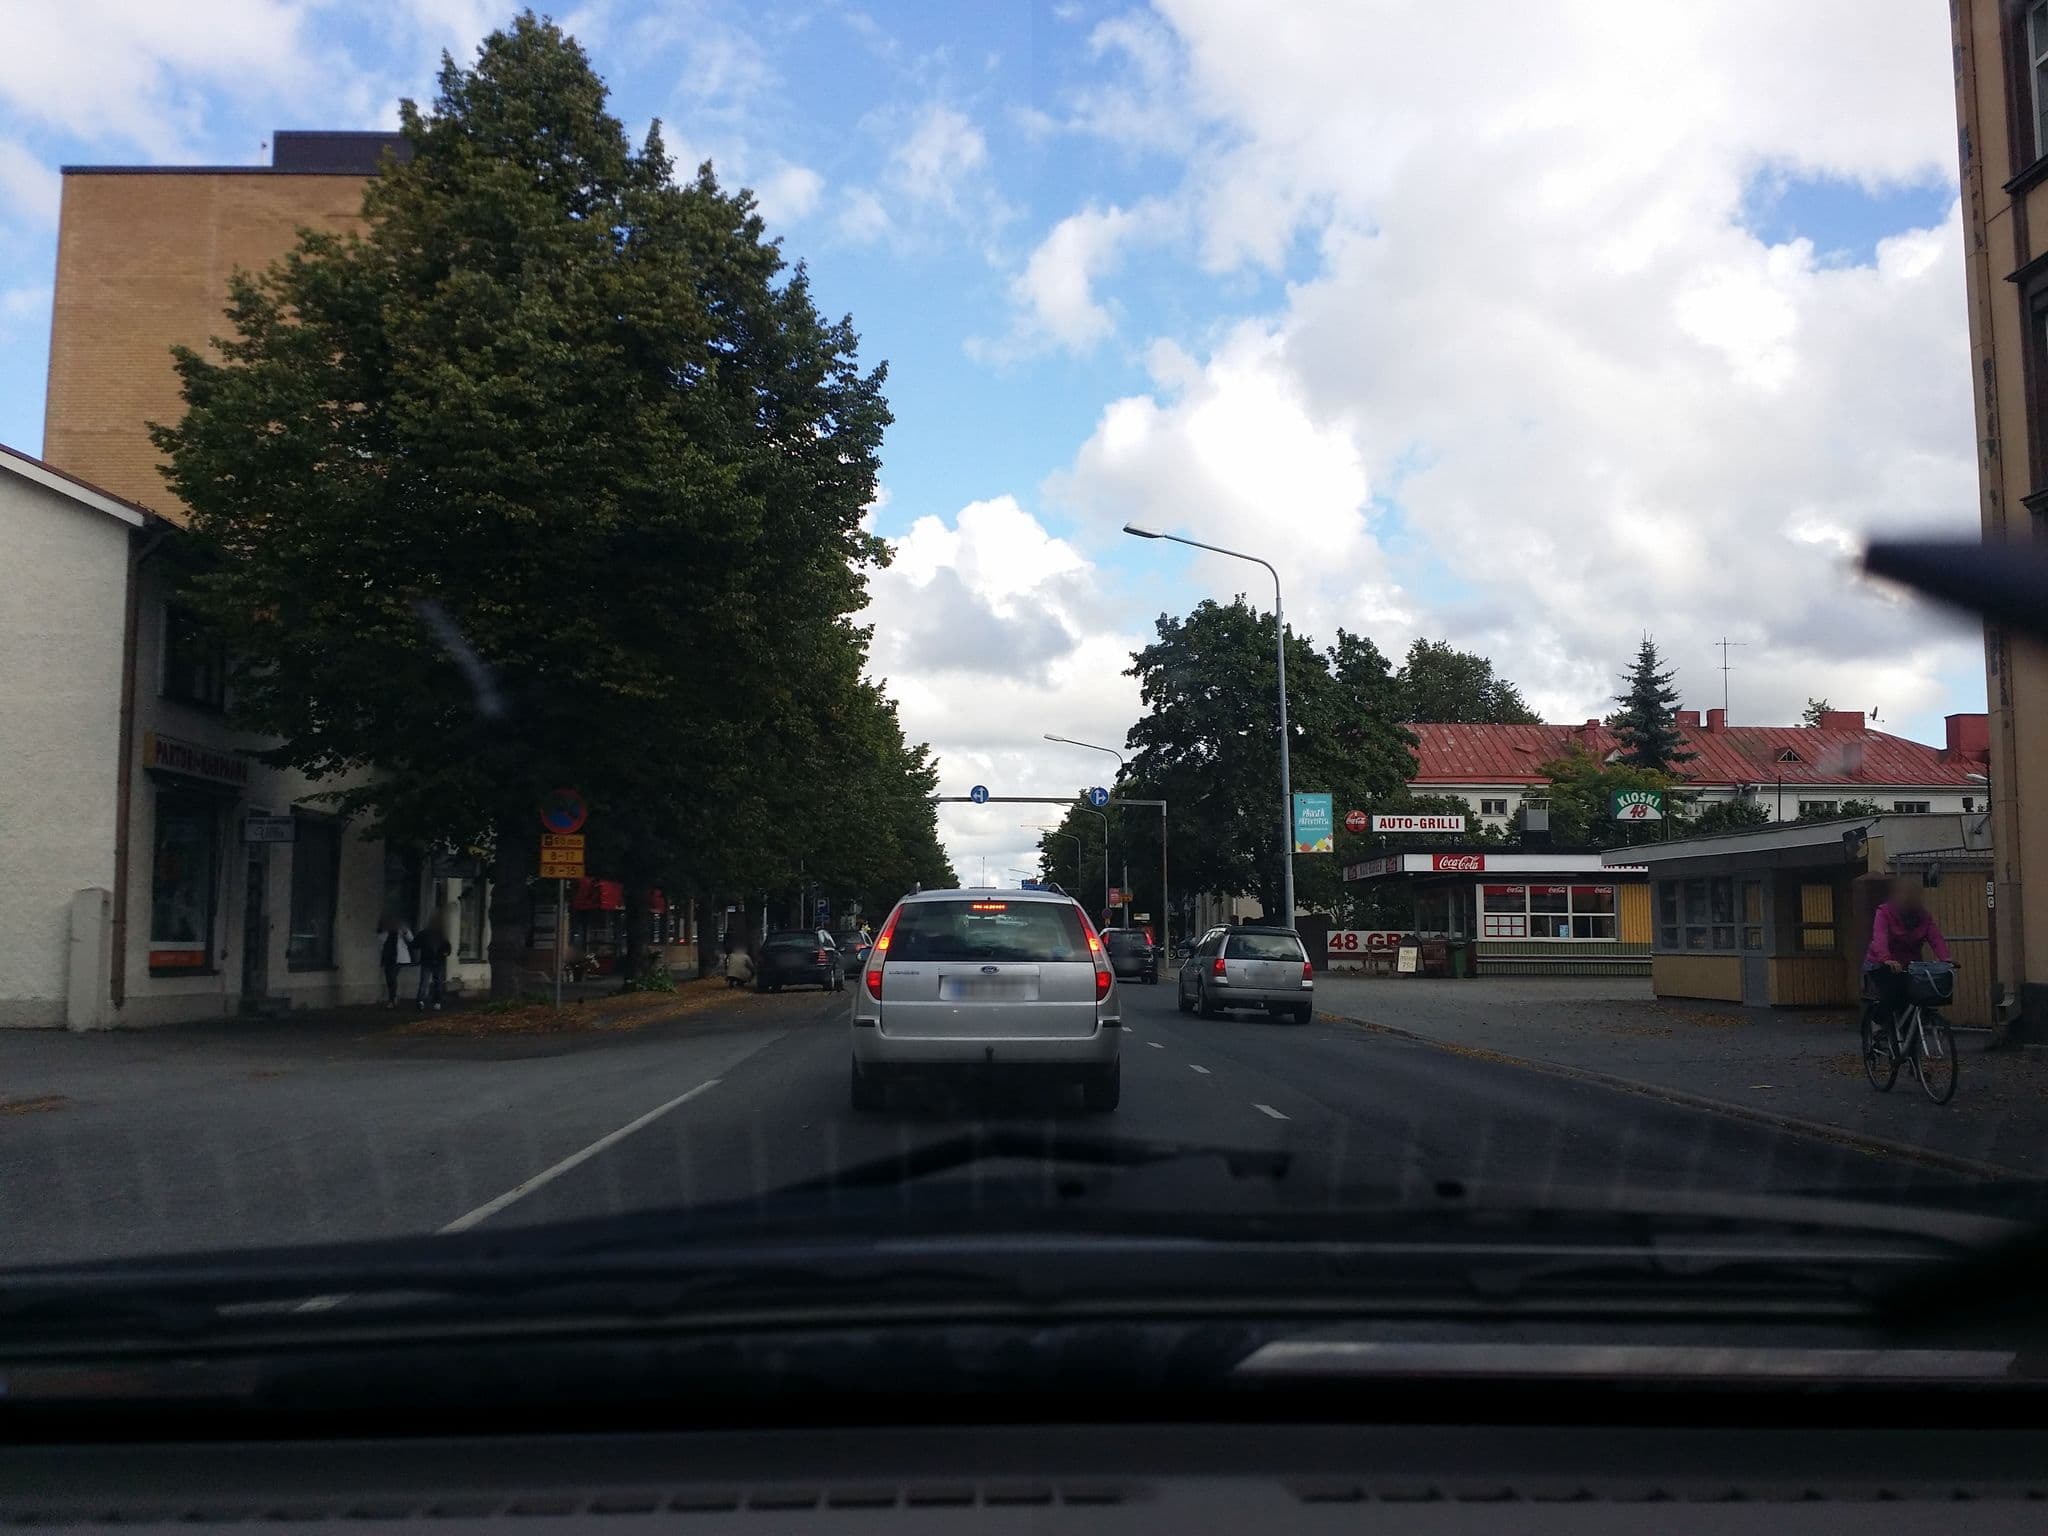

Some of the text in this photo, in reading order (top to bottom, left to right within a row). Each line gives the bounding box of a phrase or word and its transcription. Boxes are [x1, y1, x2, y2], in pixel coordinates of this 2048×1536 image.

[1617, 792, 1660, 807] KIOSKI
[1630, 805, 1648, 818] 48
[1379, 817, 1459, 829] AUTO-GRILLI
[1439, 855, 1480, 870] Coca-Cola
[1328, 933, 1359, 950] 48
